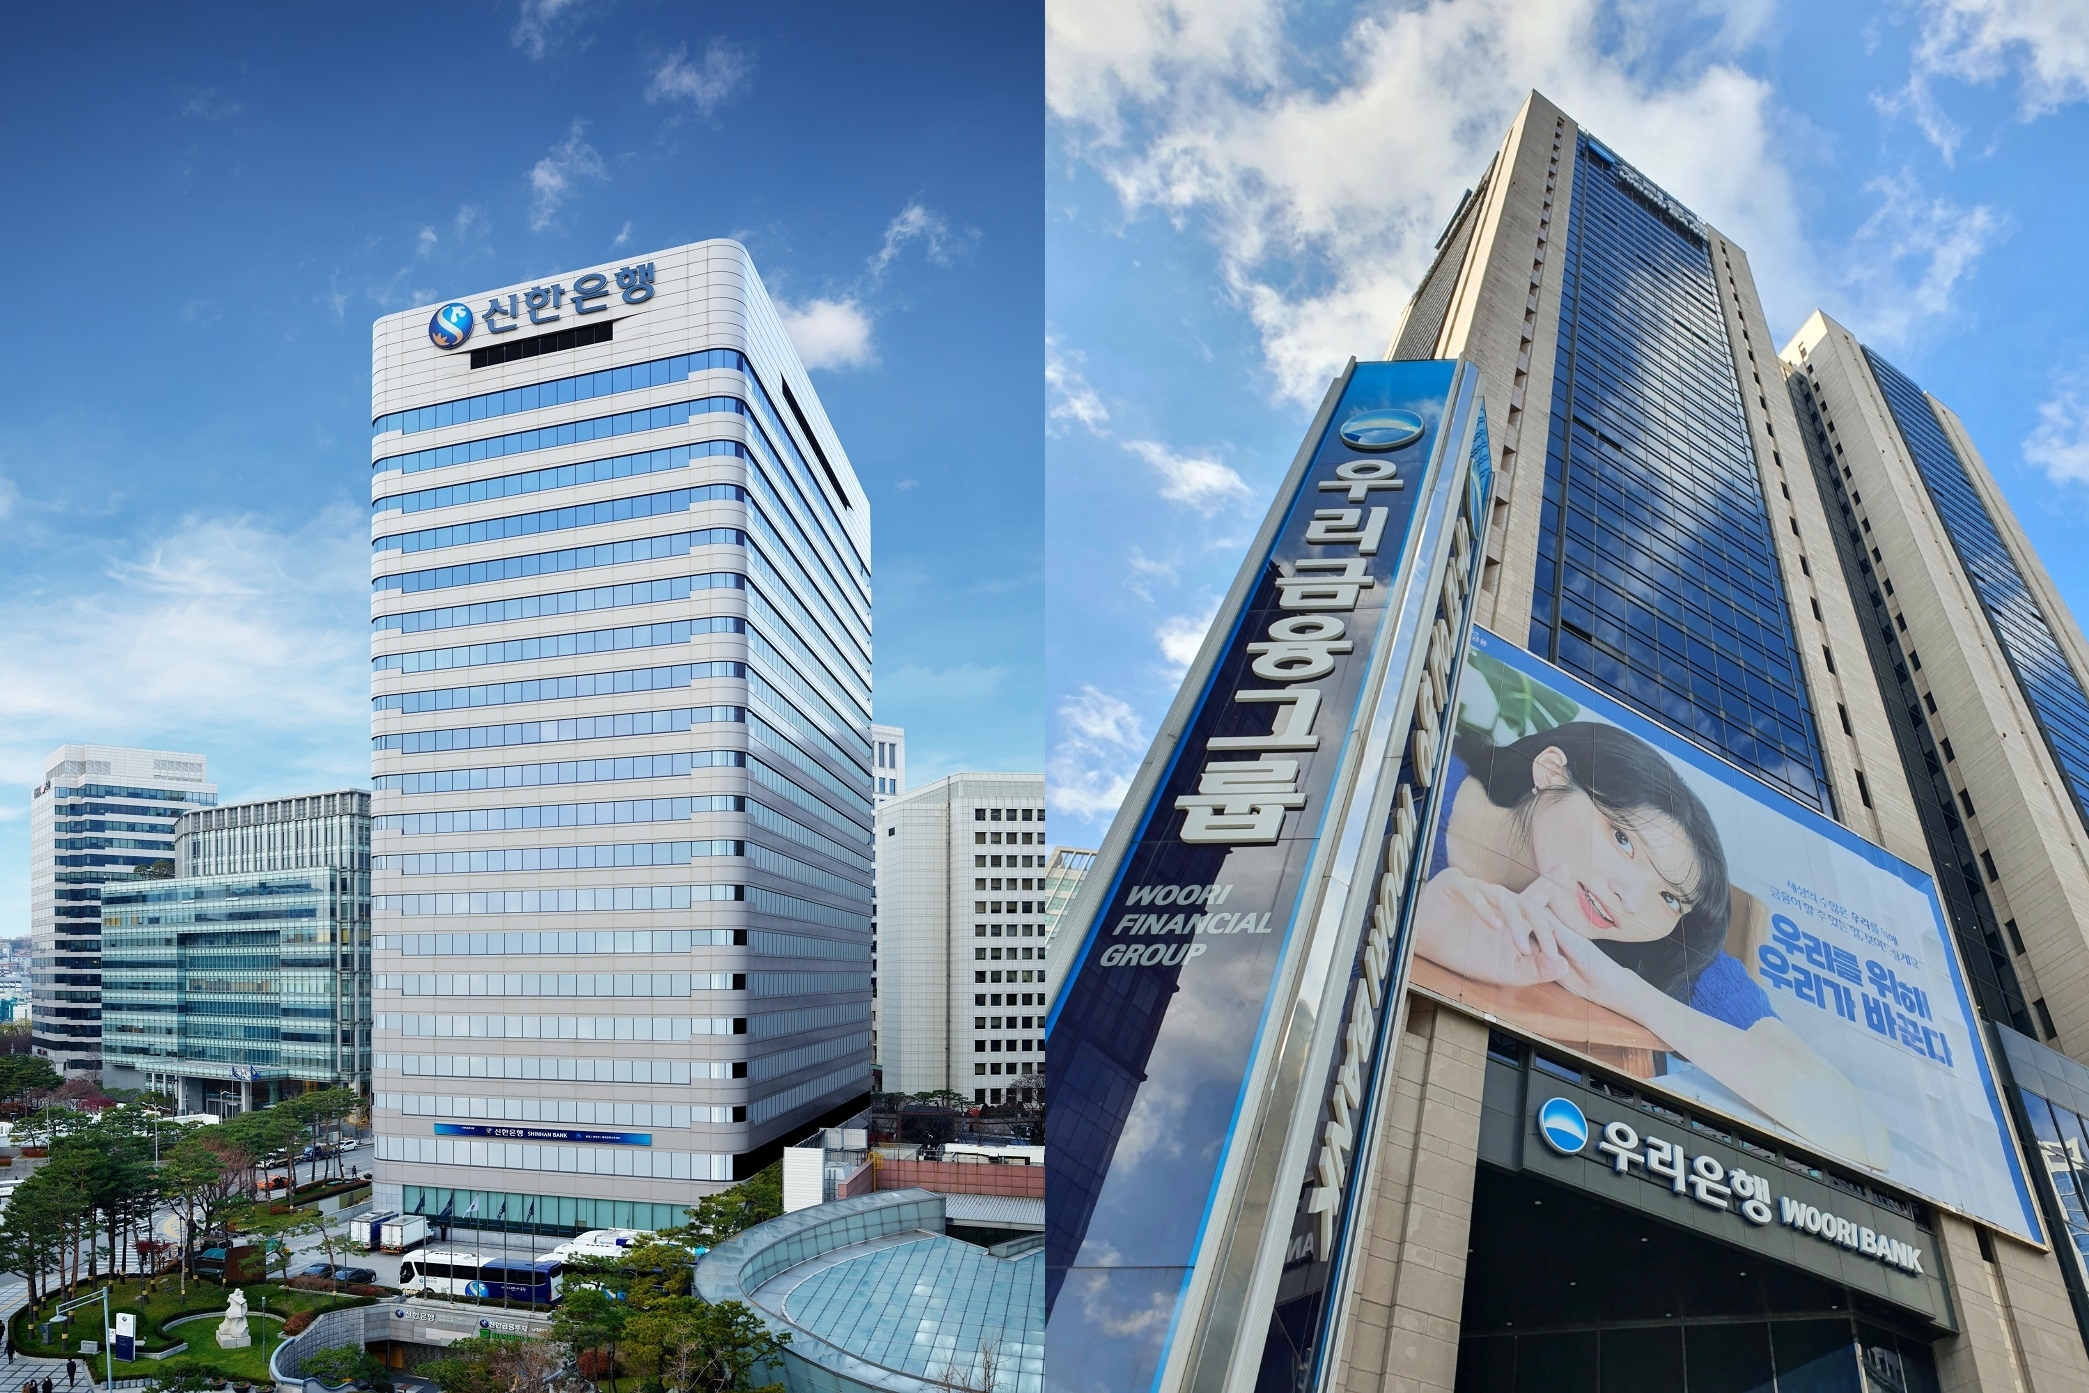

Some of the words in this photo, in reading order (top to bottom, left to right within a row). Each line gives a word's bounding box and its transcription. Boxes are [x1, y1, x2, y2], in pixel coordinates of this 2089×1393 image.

[482, 262, 655, 334] 신한은행
[1174, 459, 1404, 844] 우리금융그룹
[1412, 516, 1470, 788] 우리은행
[1112, 912, 1273, 936] FINANCIAL
[1125, 884, 1233, 906] WOORI
[1361, 783, 1418, 1008] WOORI
[1770, 888, 1802, 911] 금융이
[1803, 902, 1815, 917] 할
[1816, 911, 1827, 922] 수
[1828, 914, 1850, 934] 있는
[1786, 880, 1817, 904] 세상의
[1819, 897, 1850, 920] 수많은
[1851, 912, 1880, 936] 우리를
[1881, 928, 1899, 947] 위해
[1100, 944, 1207, 967] GROUP
[1771, 913, 1863, 988] 우리를
[1865, 959, 1933, 1022] 위해
[1758, 944, 1856, 1023] 우리가
[1861, 992, 1954, 1068] 바꾼다
[494, 1128, 524, 1137] 신한은행
[1308, 977, 1375, 1262] BANK
[1598, 1121, 1773, 1226] 우리은행
[1779, 1196, 1858, 1250] WOORI
[1859, 1226, 1924, 1275] BANK
[405, 1311, 436, 1322] 신한은행
